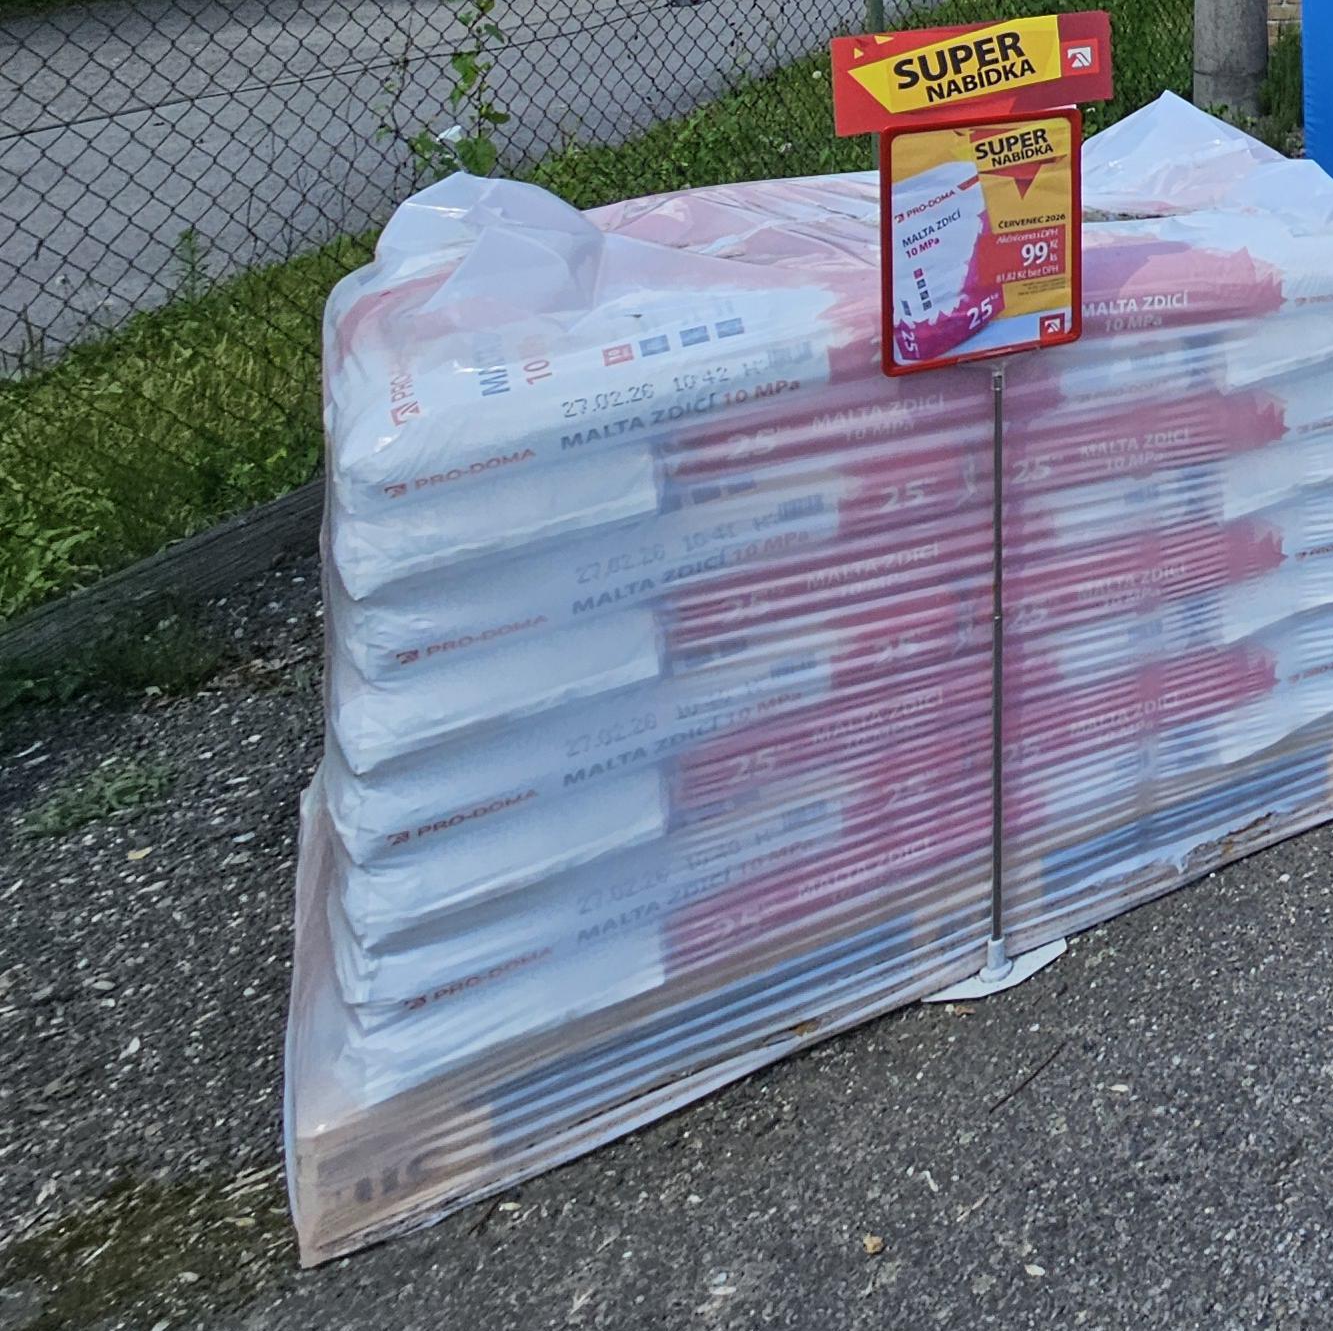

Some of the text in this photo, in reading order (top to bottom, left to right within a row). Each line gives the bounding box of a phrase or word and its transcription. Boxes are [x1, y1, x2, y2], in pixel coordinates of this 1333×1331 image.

[893, 31, 1025, 90] SUPER
[925, 59, 1036, 102] NABÍDKA
[974, 128, 1049, 160] SUPER
[991, 143, 1054, 168] NABÍDKA
[906, 189, 955, 219] PRO-DOMA
[1045, 213, 1066, 223] 2026
[902, 209, 961, 248] MALTA ZDICÍ
[905, 237, 940, 259] 10 MPa
[1021, 241, 1048, 267] 99
[967, 297, 993, 330] 25
[1082, 289, 1189, 318] MALTA ZDICÍ
[1104, 314, 1162, 333] 10 MPa
[901, 330, 917, 352] 25
[560, 379, 801, 451] MALTA ZDICÍ 10 MPa
[414, 448, 537, 490] PRO-DOMA
[1010, 455, 1052, 485] 25
[879, 477, 925, 513] 25
[571, 578, 655, 615] MALTA
[426, 614, 549, 656] PRO-DOMA
[563, 746, 649, 788] MALTA
[417, 788, 539, 838] PRO-DOMA
[577, 900, 661, 943] MALTA
